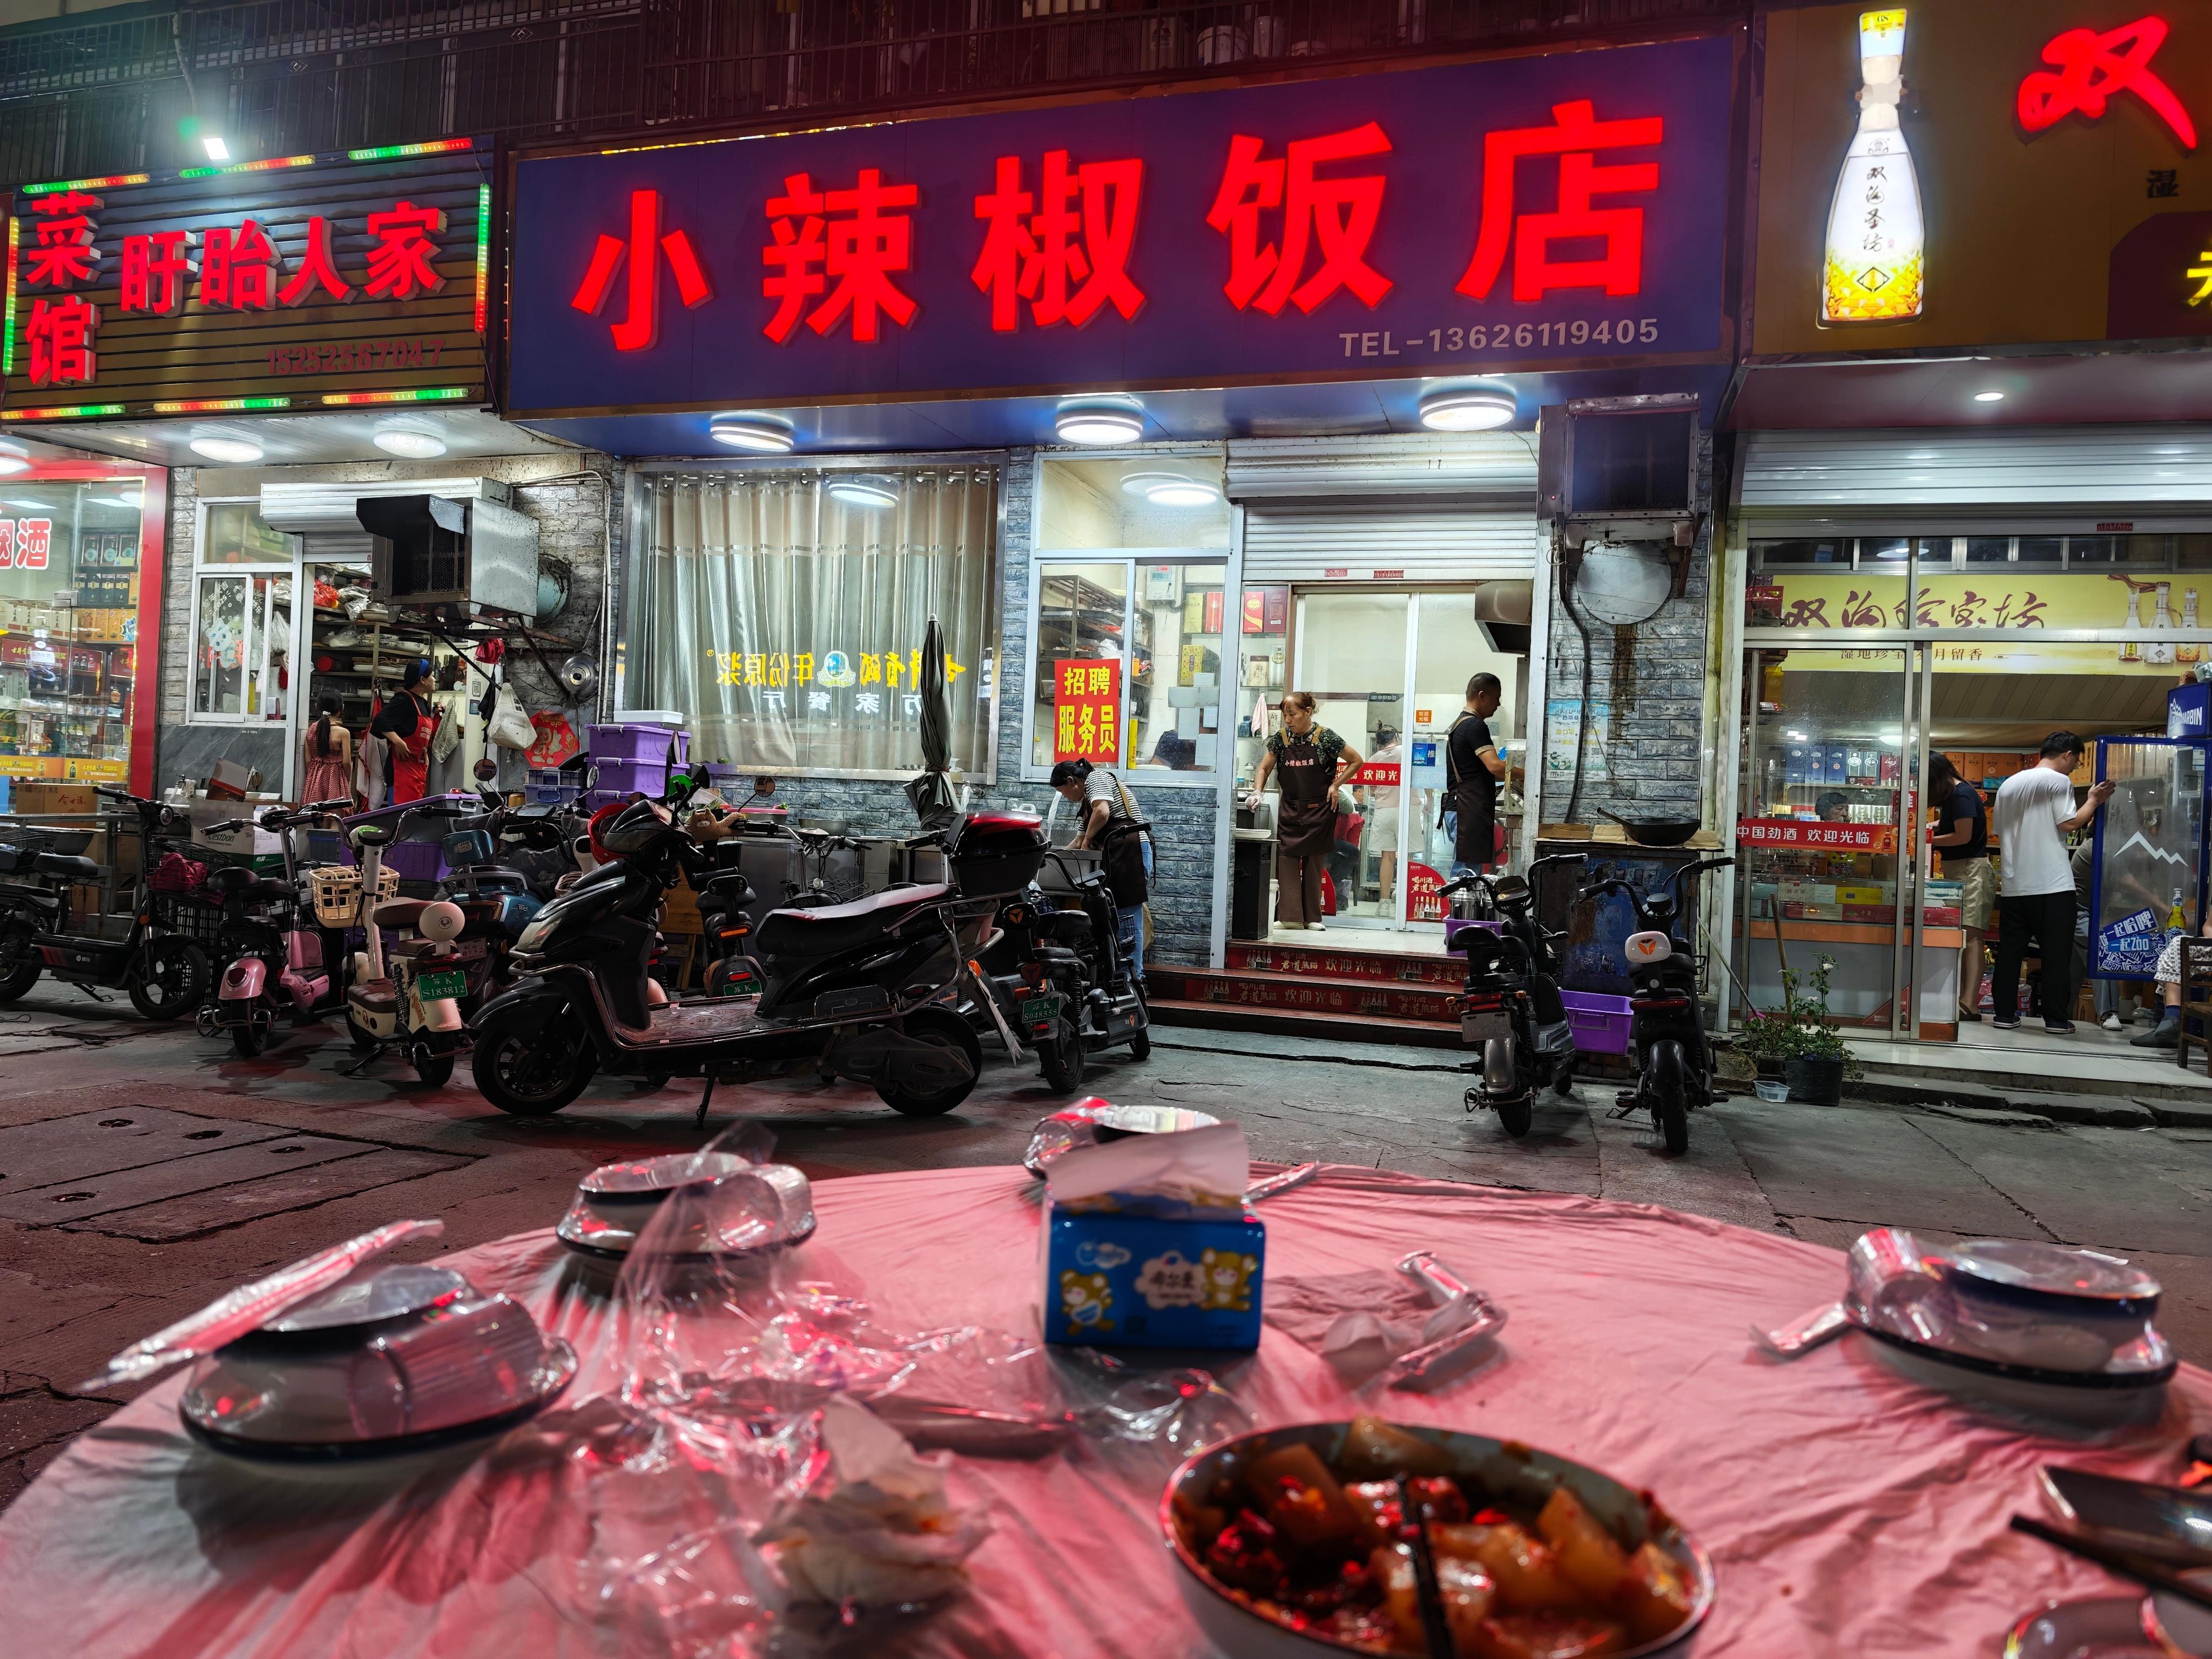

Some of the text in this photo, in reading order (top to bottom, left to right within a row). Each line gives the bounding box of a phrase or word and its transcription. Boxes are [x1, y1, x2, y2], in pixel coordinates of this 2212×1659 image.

[571, 99, 1664, 351] 小辣椒饭店
[122, 201, 446, 313] 盱眙人家
[25, 192, 99, 387] 菜馆
[1339, 318, 1658, 358] TEL-13626119405
[265, 339, 445, 375] 15252567047
[1064, 666, 1111, 696] 招聘
[1057, 703, 1116, 755] 服务员
[1285, 758, 1314, 767] 小辣椒饭店
[1364, 770, 1398, 781] 欢迎光
[1736, 826, 1871, 845] 中国劲酒 欢迎光临
[1412, 876, 1433, 884] 喝川酒
[2106, 910, 2154, 938] 一起哈啤
[1325, 957, 1381, 974] 欢迎光临
[423, 985, 466, 997] S183812
[1284, 989, 1343, 1006] 欢迎光临
[1023, 1008, 1057, 1021] S048555
